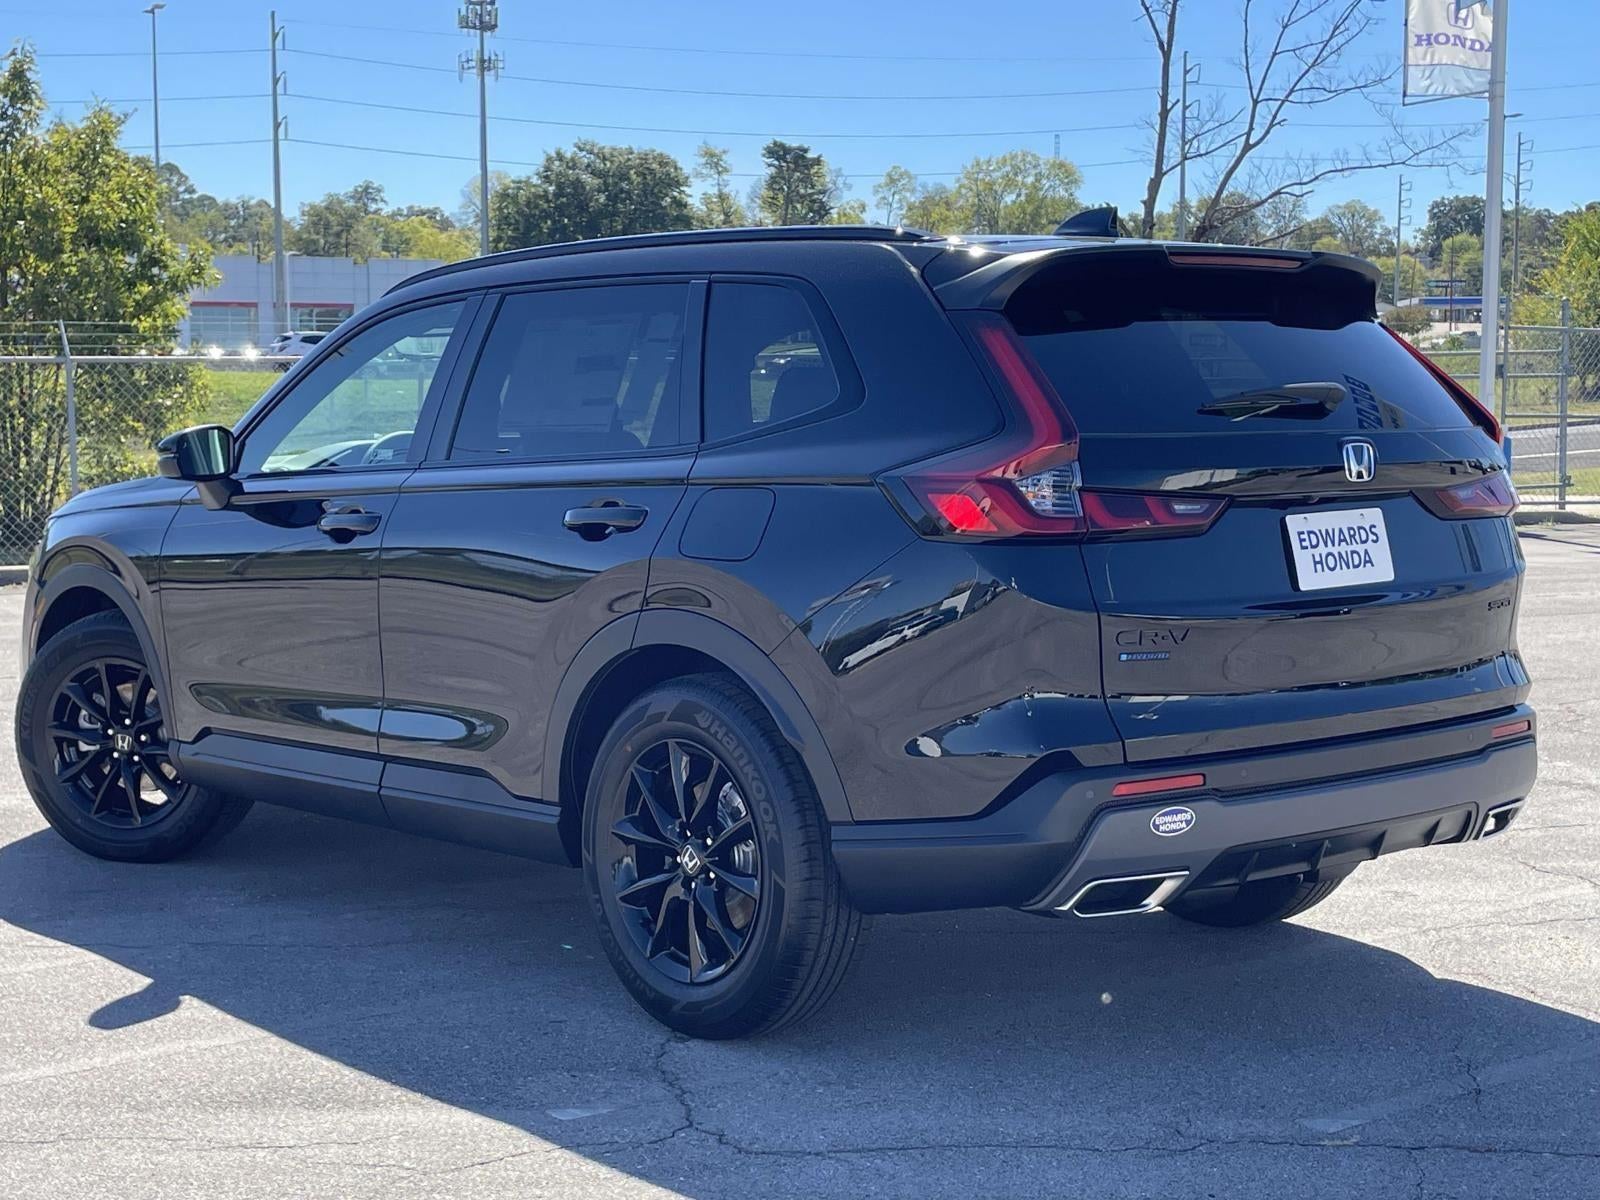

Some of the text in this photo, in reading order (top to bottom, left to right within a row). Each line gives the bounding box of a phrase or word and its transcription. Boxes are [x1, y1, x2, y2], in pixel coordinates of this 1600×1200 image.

[1296, 524, 1379, 550] EDWARDS
[1311, 548, 1375, 573] HONDA
[1115, 627, 1190, 646] CR-V
[1155, 812, 1192, 825] EDWARDS
[1159, 820, 1187, 832] HONDA
